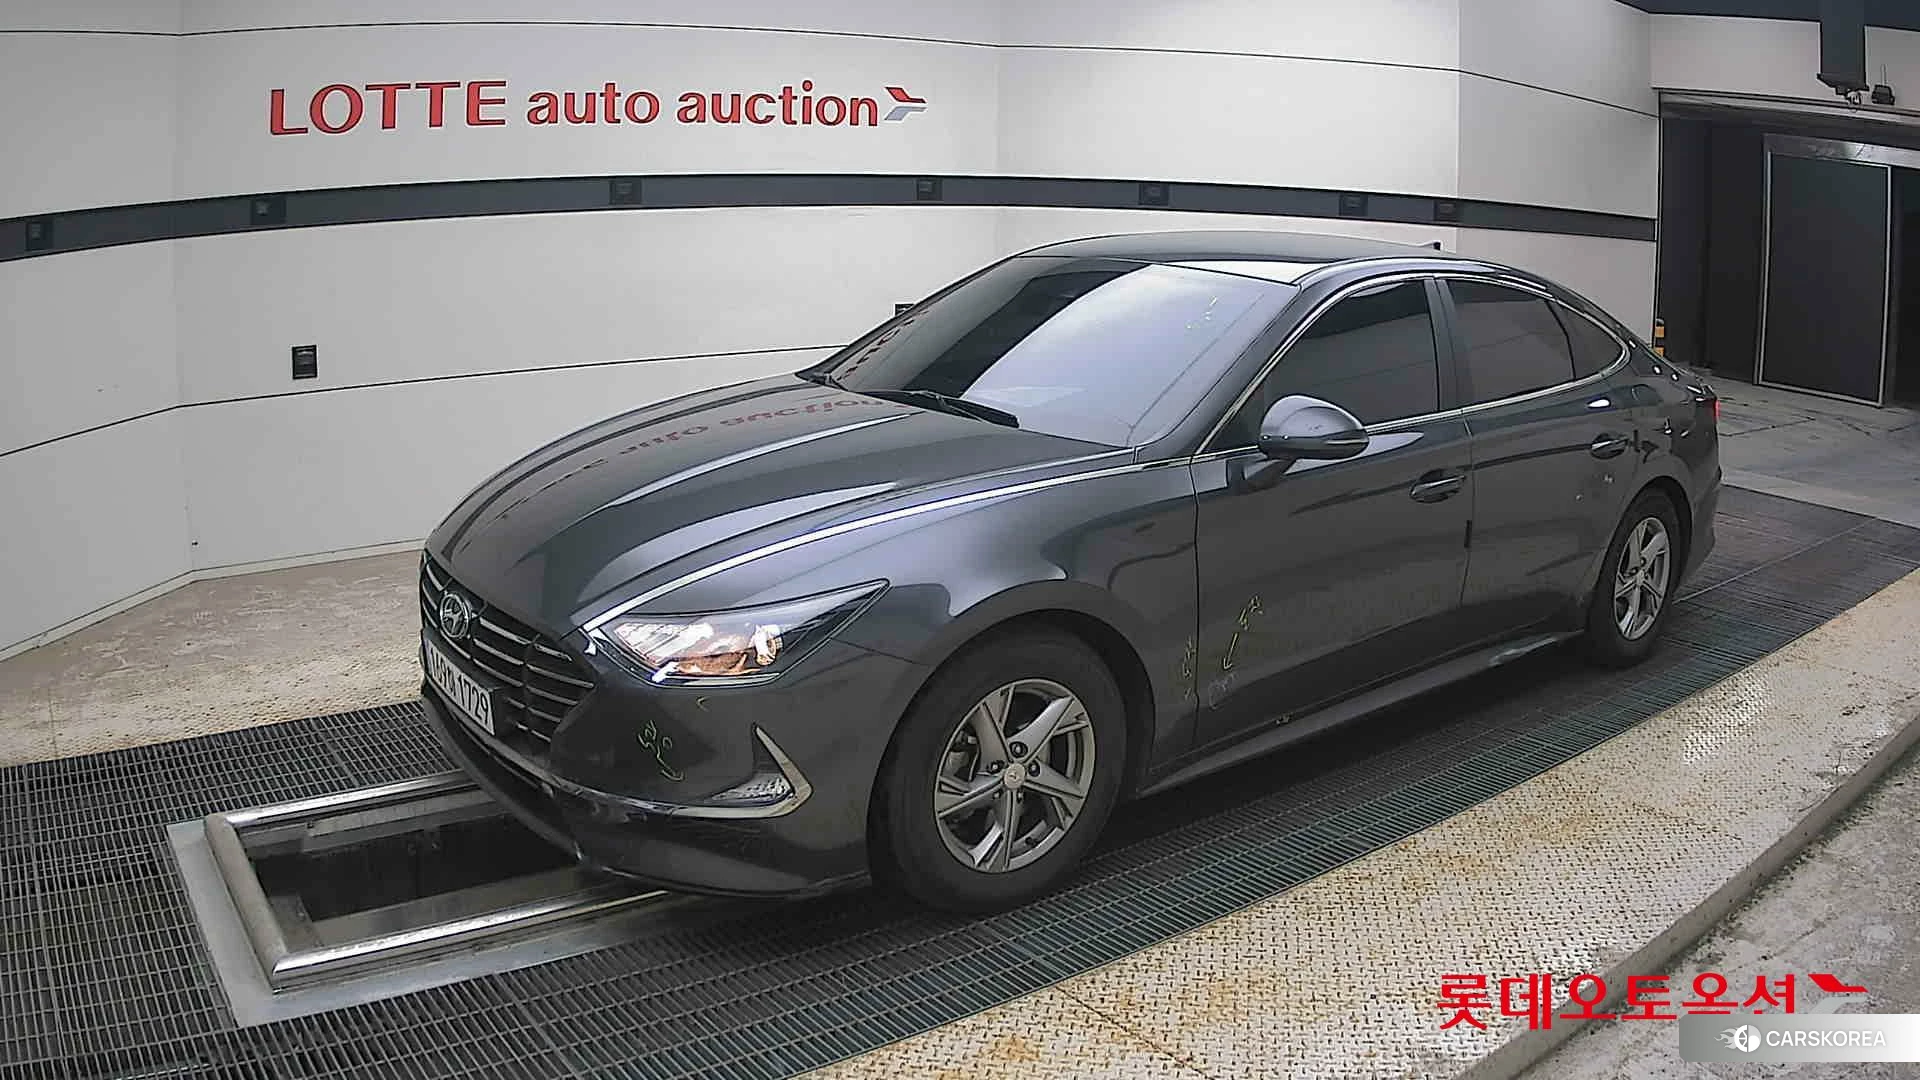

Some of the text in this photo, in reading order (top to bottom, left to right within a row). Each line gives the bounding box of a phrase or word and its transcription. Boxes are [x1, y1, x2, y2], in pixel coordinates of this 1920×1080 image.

[269, 79, 880, 136] LOTTE auto auction
[458, 672, 489, 726] 1729
